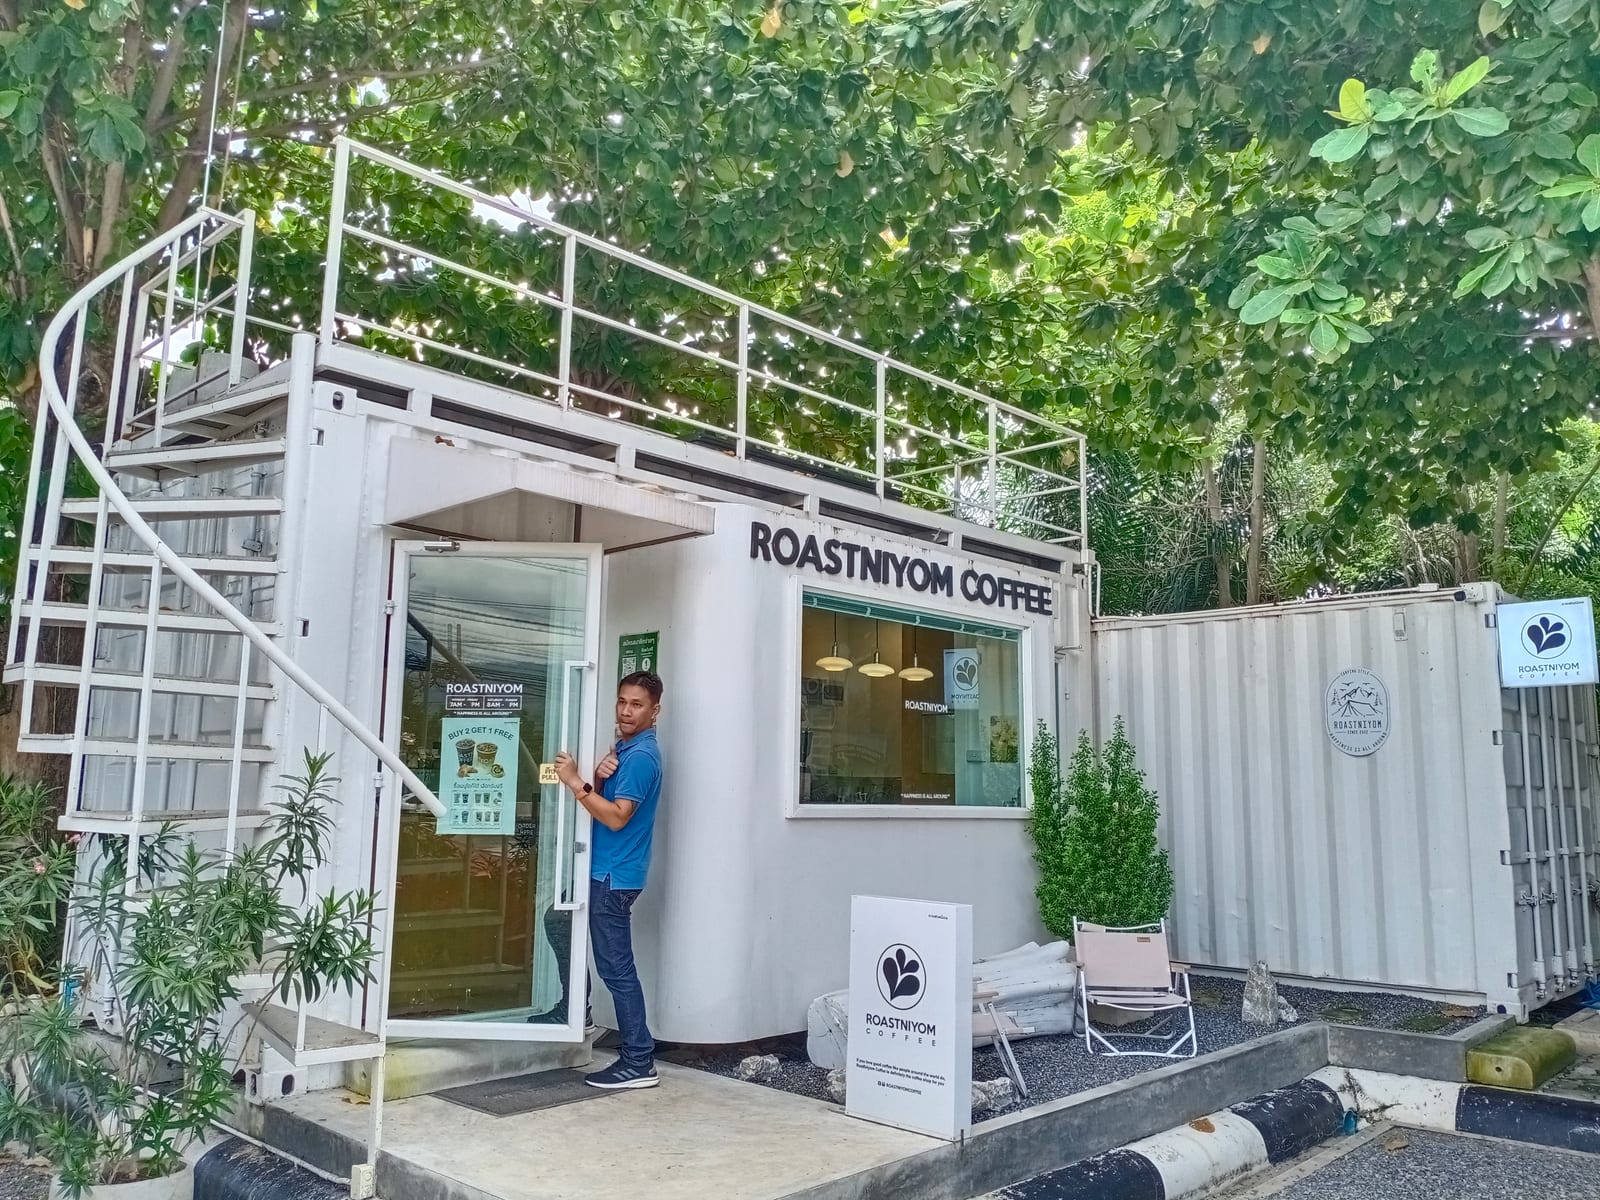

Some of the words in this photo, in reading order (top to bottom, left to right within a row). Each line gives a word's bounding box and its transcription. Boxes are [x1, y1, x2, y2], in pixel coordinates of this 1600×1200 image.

[750, 521, 954, 598] ROASTNIYOM
[960, 568, 1053, 616] COFFEE
[1518, 662, 1580, 673] ROASTNIYOM
[1519, 671, 1580, 679] COFFEE
[446, 683, 523, 694] ROASTNIYOM
[905, 700, 949, 713] ROASTNIYOM
[1334, 720, 1382, 729] ROASTNIYOM
[448, 729, 464, 740] BUY
[494, 728, 514, 740] FREE
[1330, 733, 1352, 752] HAPPINESS
[866, 1013, 936, 1036] ROASTNIYOM
[866, 1028, 936, 1047] COFFEE
